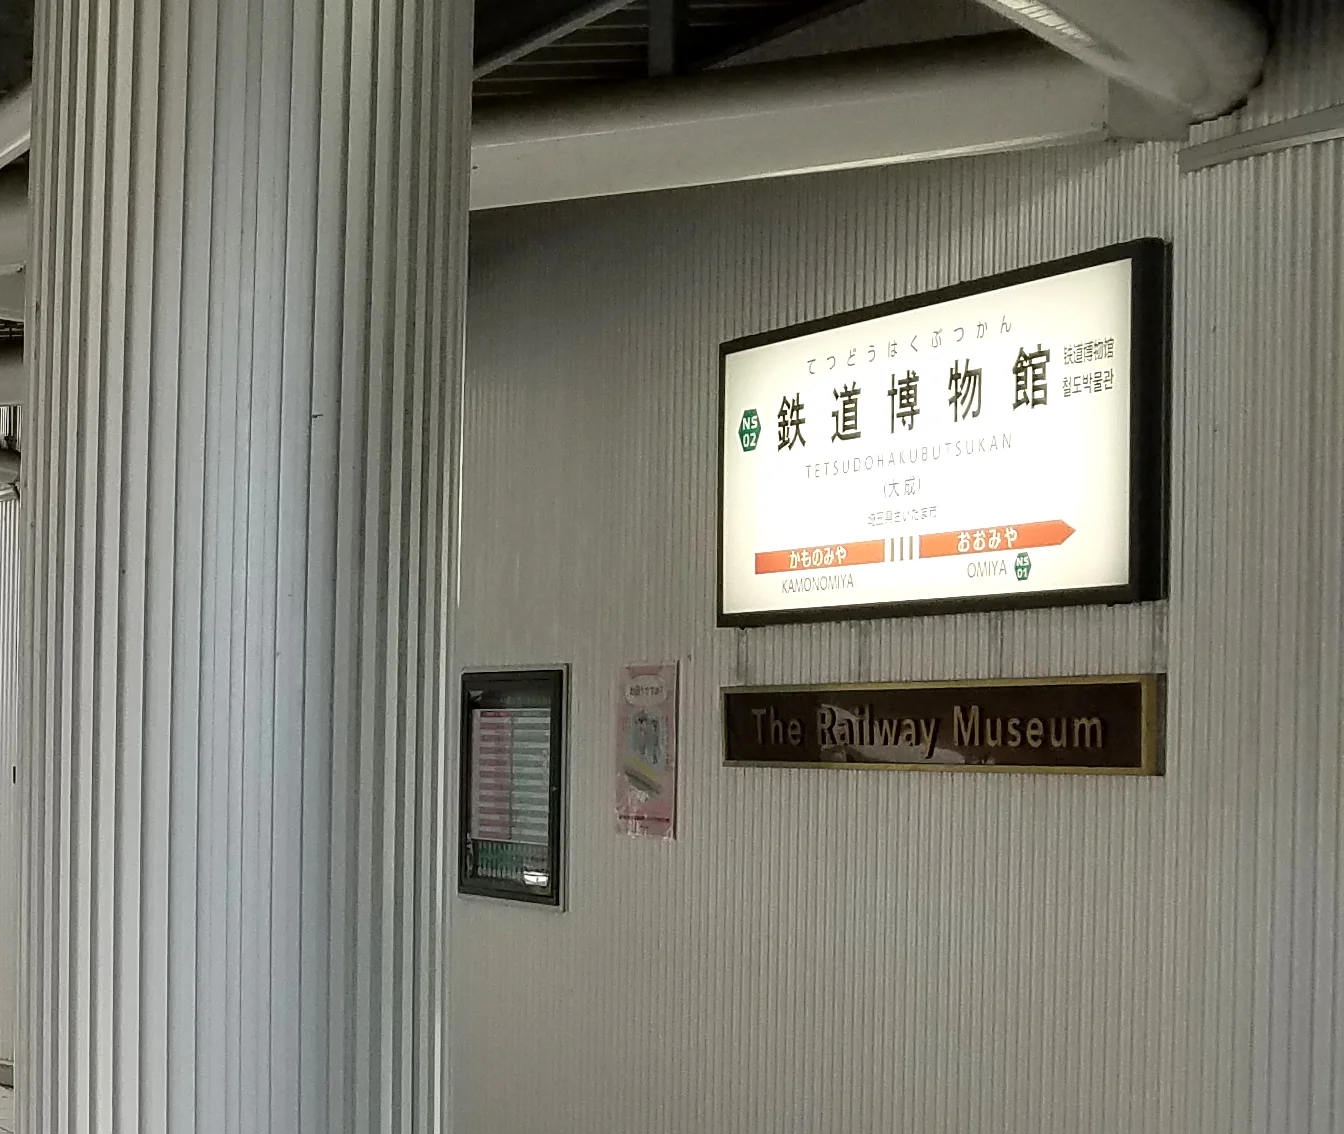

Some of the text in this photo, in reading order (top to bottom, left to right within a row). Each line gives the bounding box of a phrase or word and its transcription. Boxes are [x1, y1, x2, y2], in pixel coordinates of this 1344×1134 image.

[807, 315, 1012, 375] てつどうはくぶつかん
[1062, 368, 1114, 398] 철도박물관
[776, 343, 1050, 452] 鉄道博物館
[742, 414, 758, 430] NS
[742, 432, 757, 448] 02
[806, 434, 1012, 479] TETSUDOHAKUBUTSUKAN
[883, 476, 922, 498] (大成)
[957, 527, 1018, 553] おおみや
[789, 545, 847, 569] かものみや
[1015, 556, 1029, 567] NS
[967, 560, 1008, 578] OMIYA
[1016, 567, 1028, 579] 01
[782, 574, 854, 594] KAMONOMIYA
[752, 703, 1104, 760] The Railway Museum
